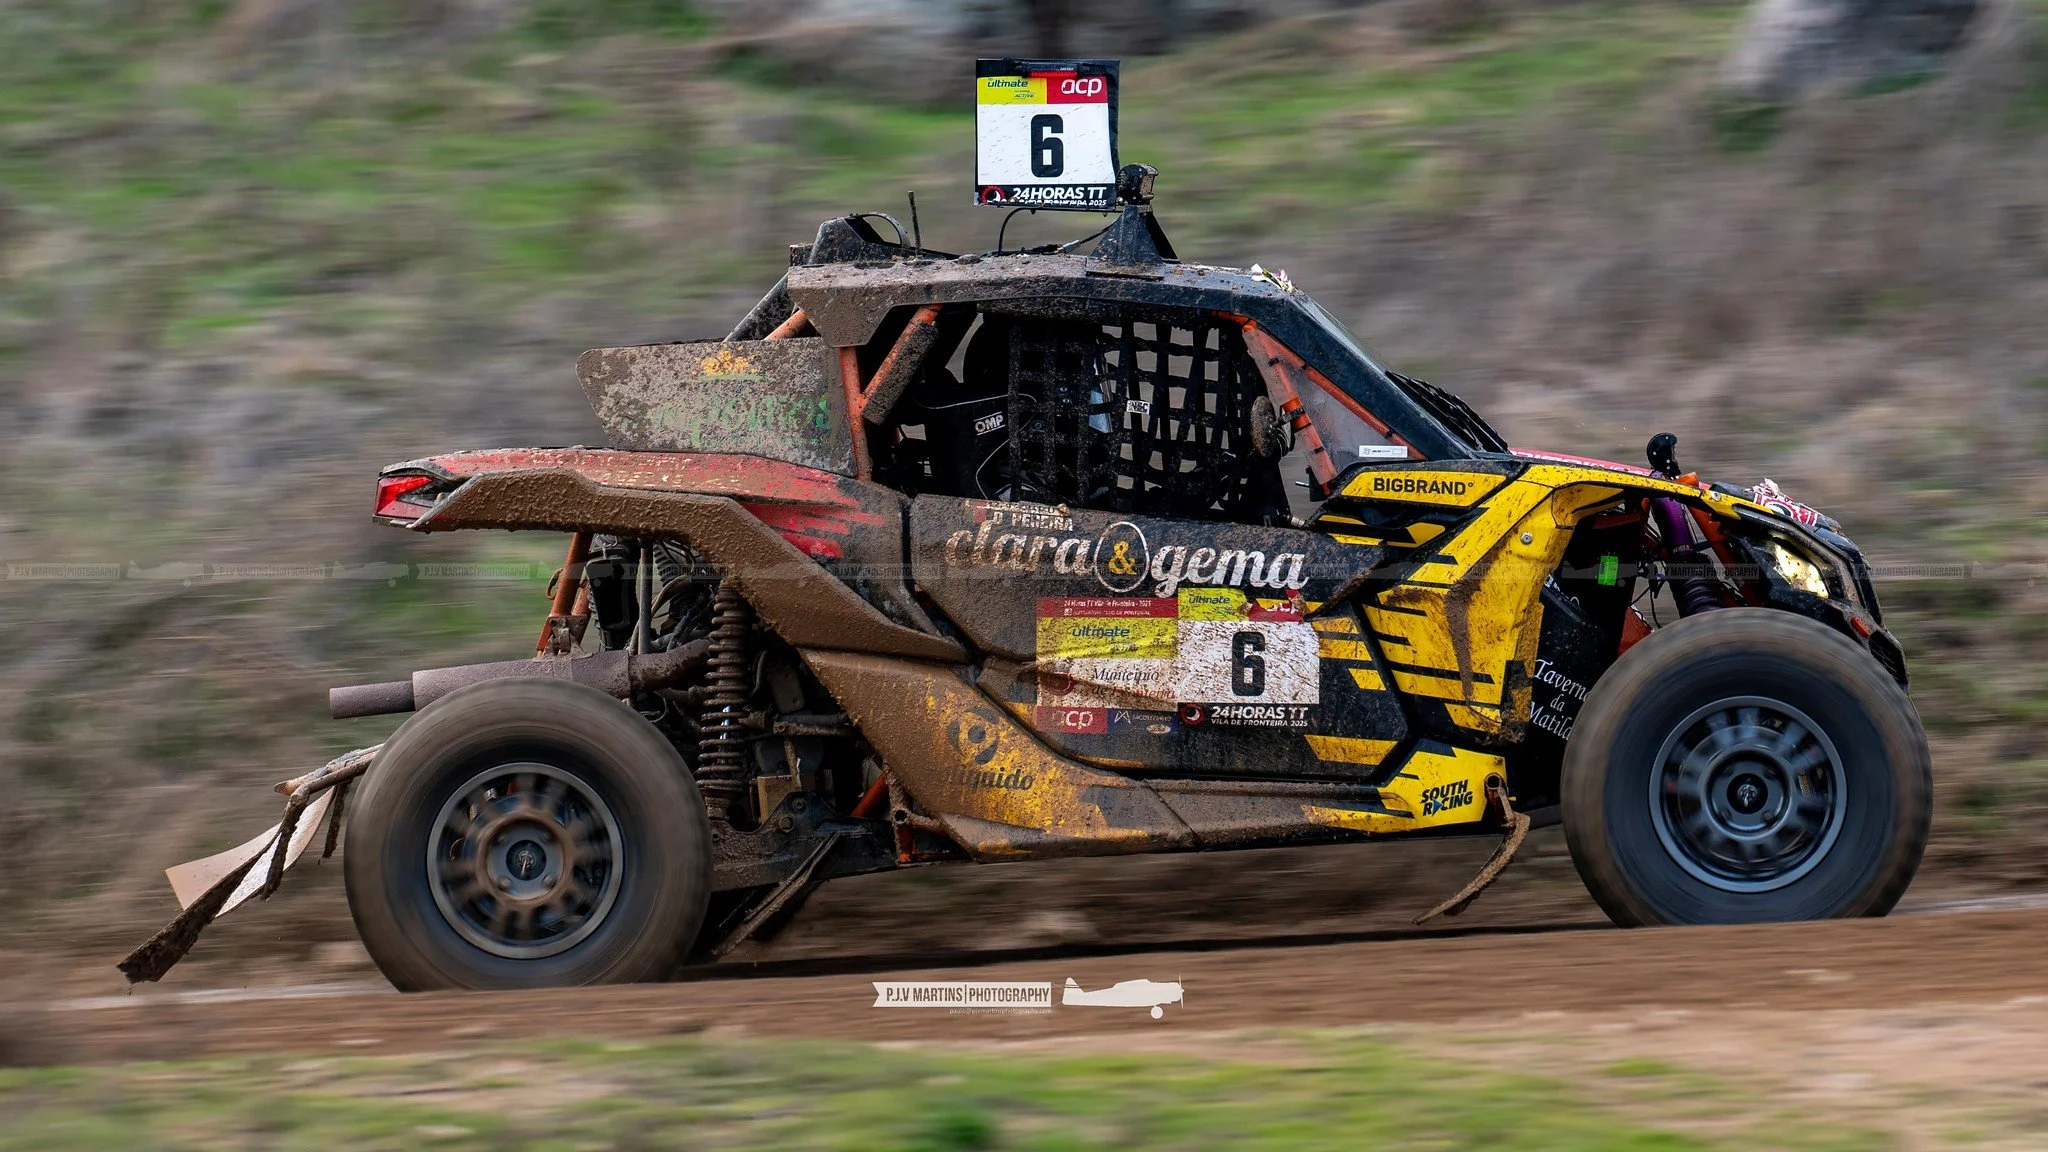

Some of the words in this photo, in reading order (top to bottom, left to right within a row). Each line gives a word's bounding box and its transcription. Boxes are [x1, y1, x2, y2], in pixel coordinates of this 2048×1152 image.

[988, 79, 1029, 88] ultimate
[1061, 78, 1102, 96] acp
[1031, 113, 1064, 178] 6
[1087, 187, 1107, 200] TT
[975, 415, 1004, 432] OMP
[945, 519, 1097, 577] clara
[1109, 541, 1136, 576] &
[1151, 545, 1309, 598] gema
[1188, 595, 1231, 604] ultimate
[1232, 632, 1265, 696] 6
[1550, 693, 1566, 712] da
[1289, 706, 1309, 720] TT
[1243, 719, 1288, 727] FRONTEIRA
[1421, 779, 1469, 803] SOUTH
